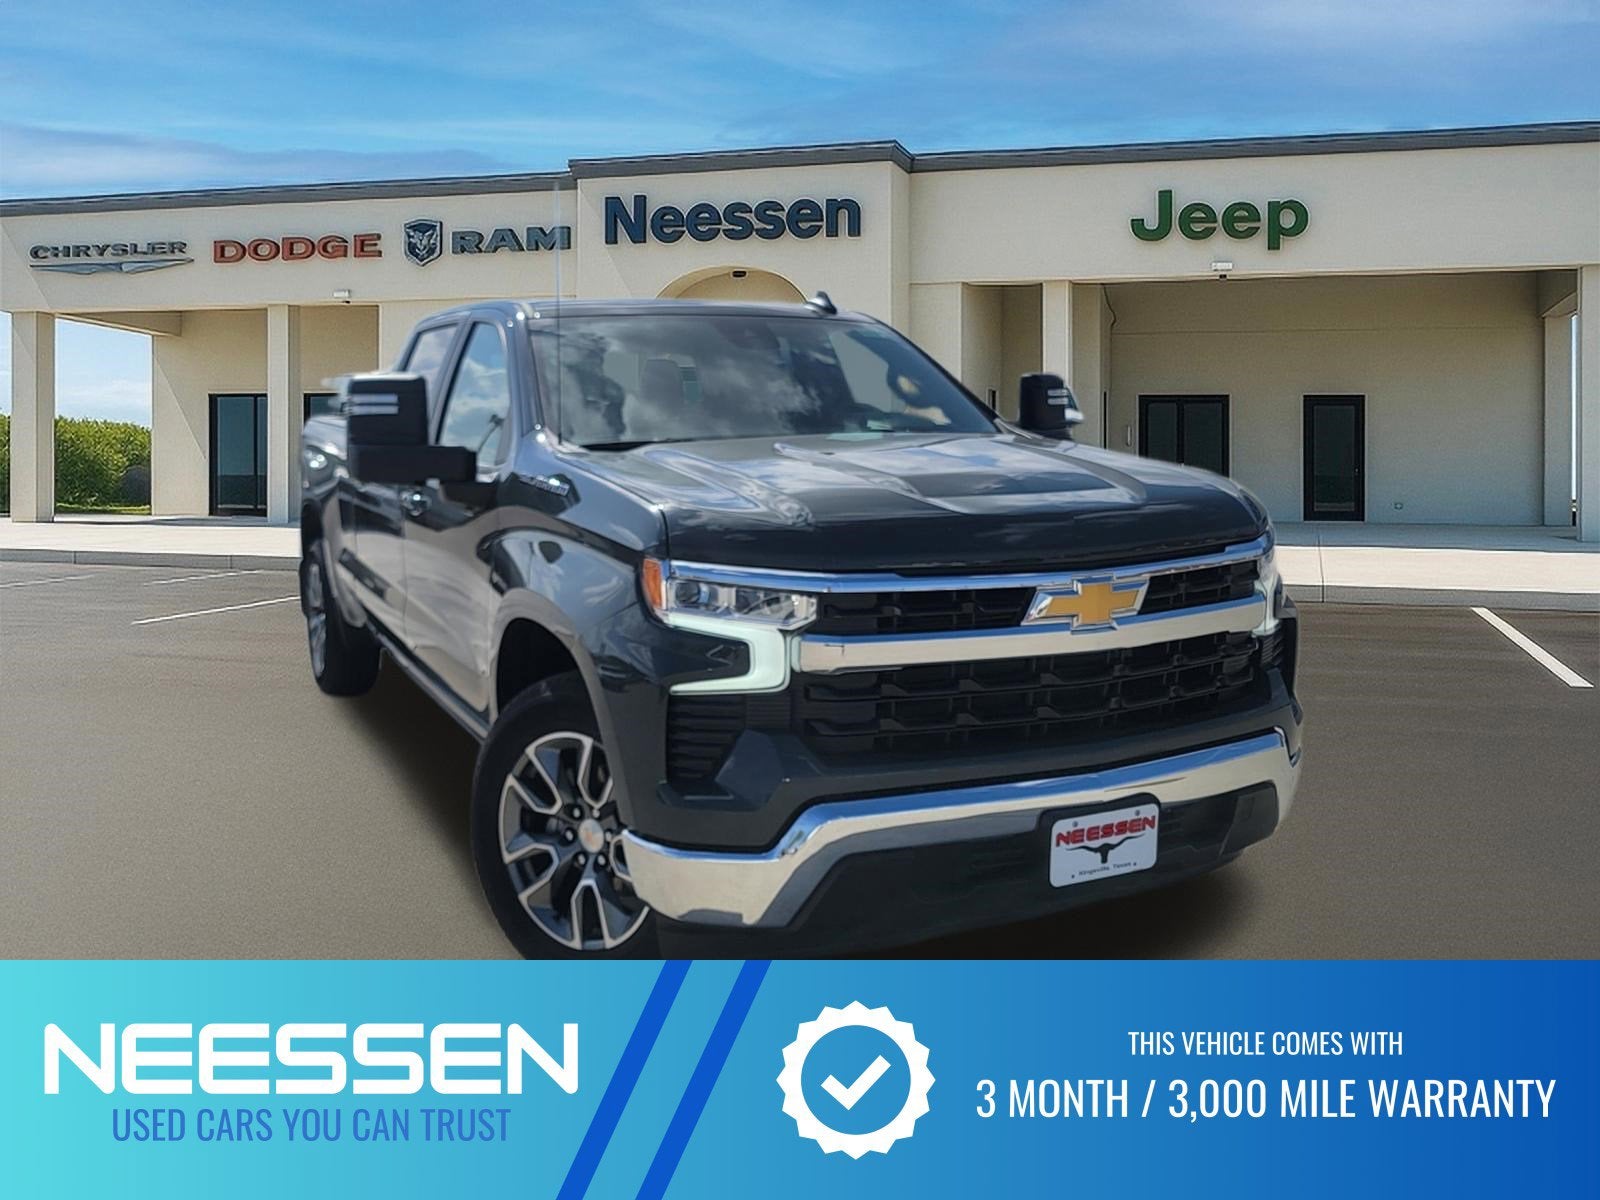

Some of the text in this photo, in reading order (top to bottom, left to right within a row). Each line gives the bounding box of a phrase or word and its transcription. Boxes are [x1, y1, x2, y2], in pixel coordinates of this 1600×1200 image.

[605, 195, 861, 244] Neessen
[1131, 190, 1308, 250] Jeep
[30, 241, 187, 259] CHRYSLER
[214, 233, 382, 263] DODGE
[452, 226, 571, 254] RAM
[1056, 816, 1155, 847] NEESSEN
